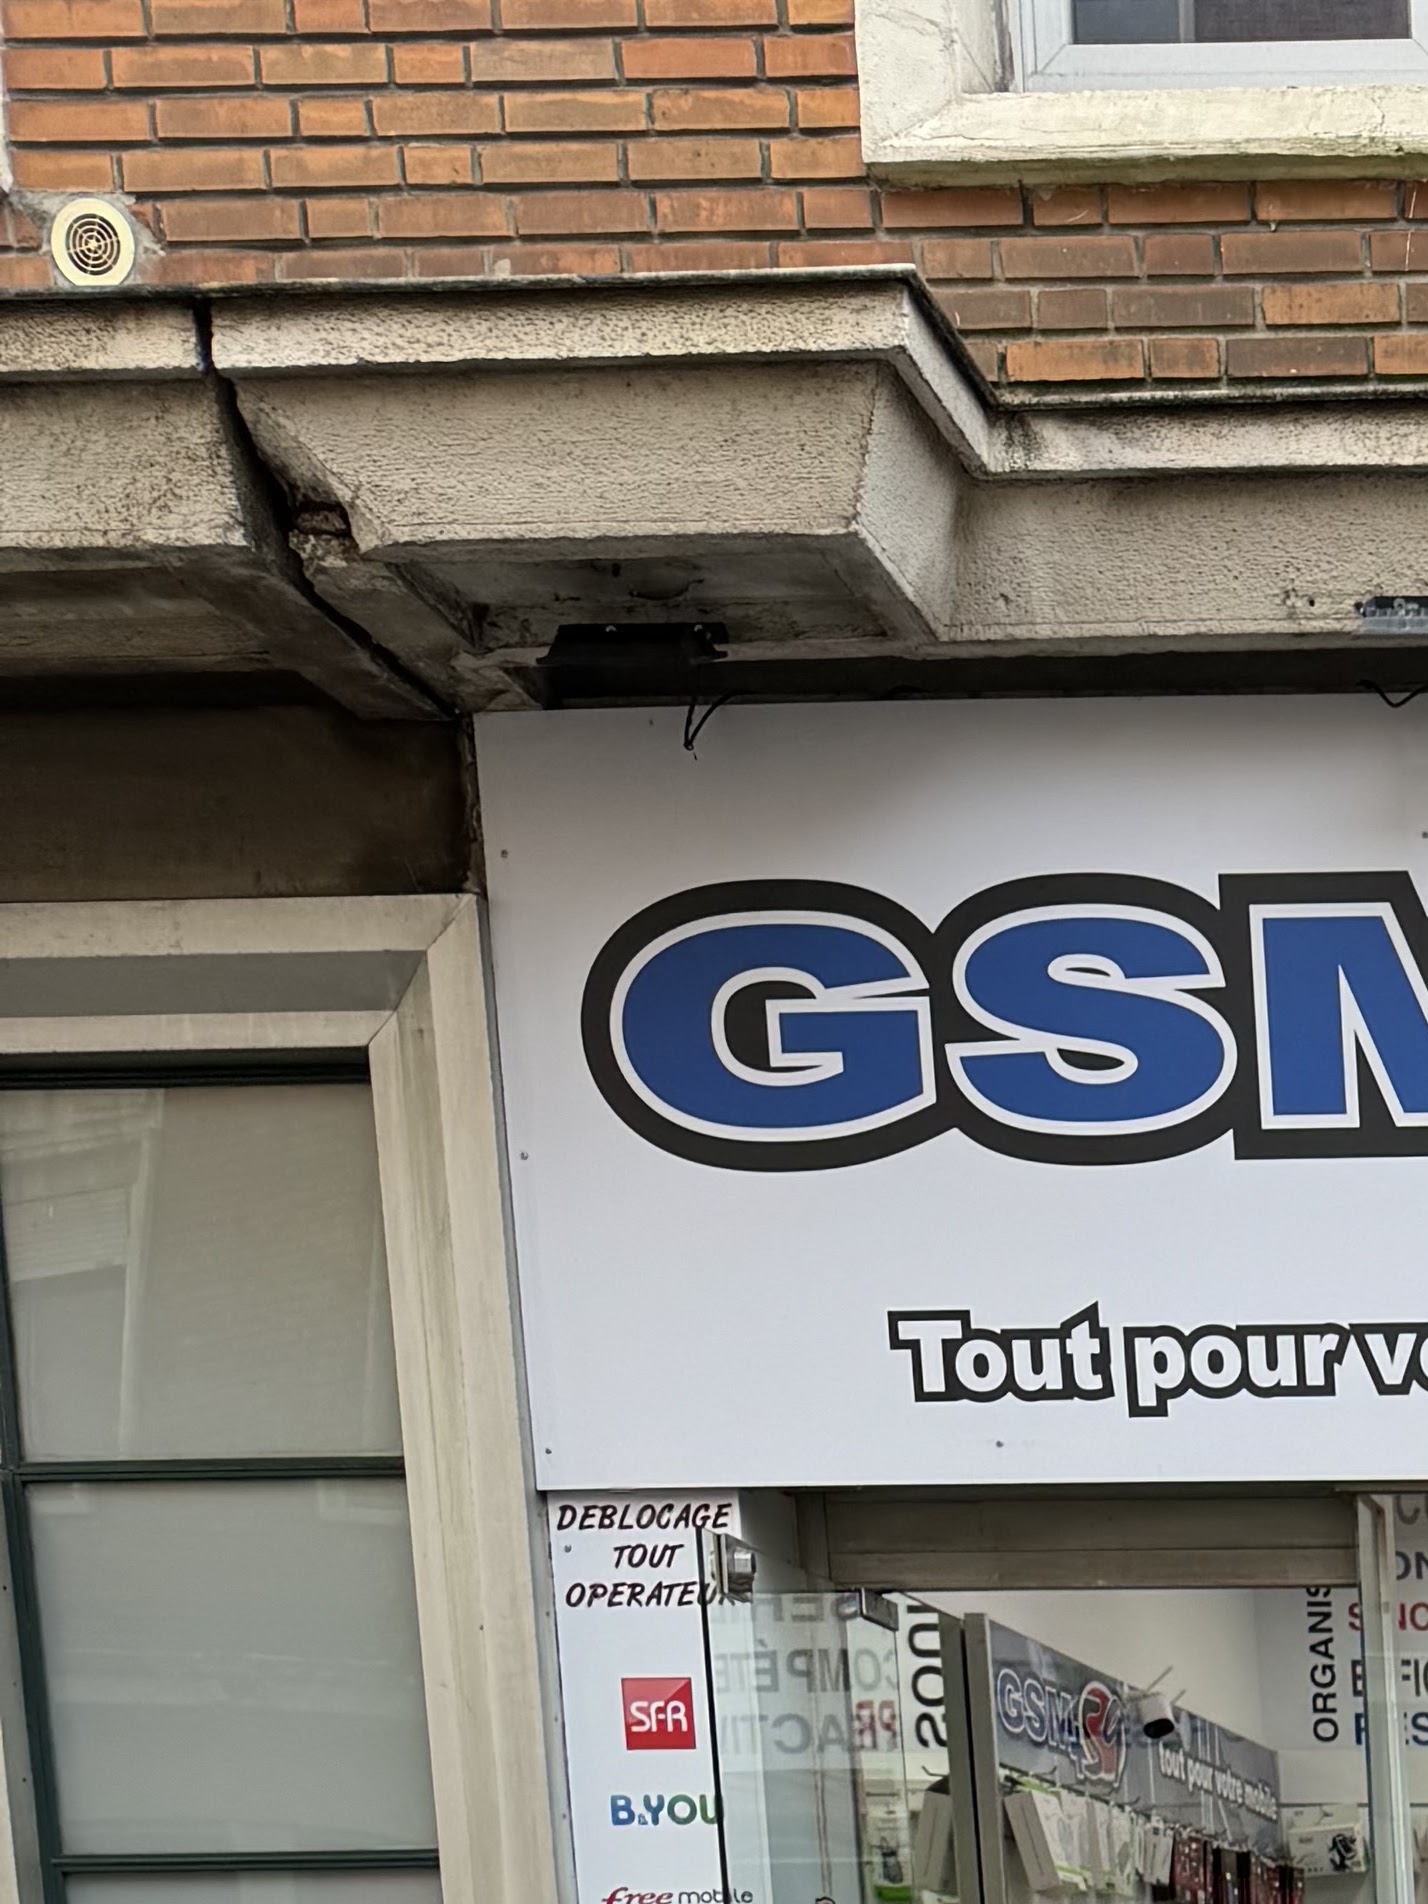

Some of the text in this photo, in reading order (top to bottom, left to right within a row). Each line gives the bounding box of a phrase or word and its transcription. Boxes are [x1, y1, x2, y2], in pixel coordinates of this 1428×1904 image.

[887, 1301, 1112, 1402] Tout
[1122, 1324, 1349, 1418] pour
[557, 1503, 732, 1531] DEBLOCAGE
[613, 1544, 684, 1568] TOUT
[630, 1700, 688, 1732] SFR
